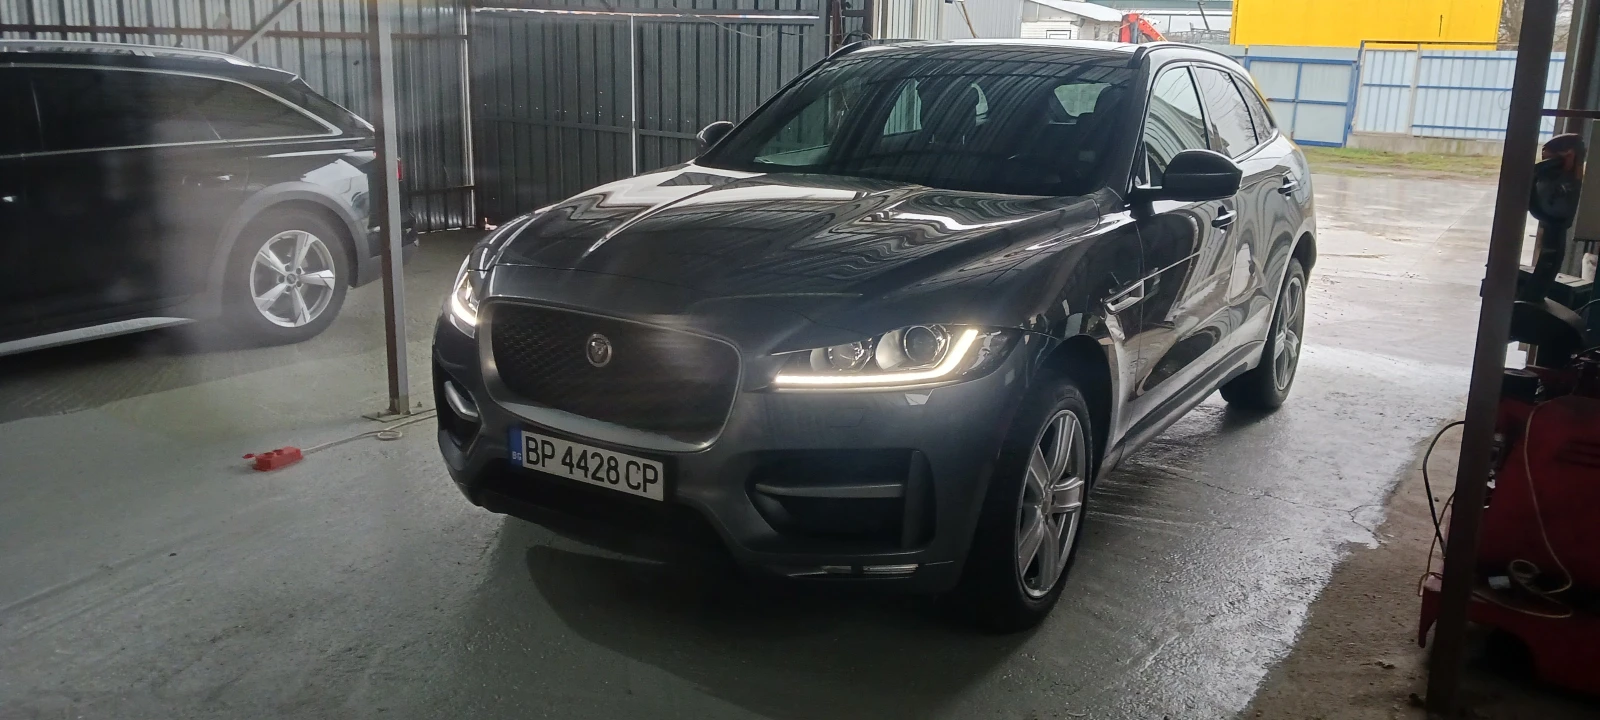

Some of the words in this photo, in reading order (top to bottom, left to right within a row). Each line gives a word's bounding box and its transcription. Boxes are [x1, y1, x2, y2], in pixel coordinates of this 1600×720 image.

[512, 451, 521, 460] BG
[525, 436, 555, 467] BP
[561, 446, 620, 484] 4428
[625, 460, 658, 492] CP
